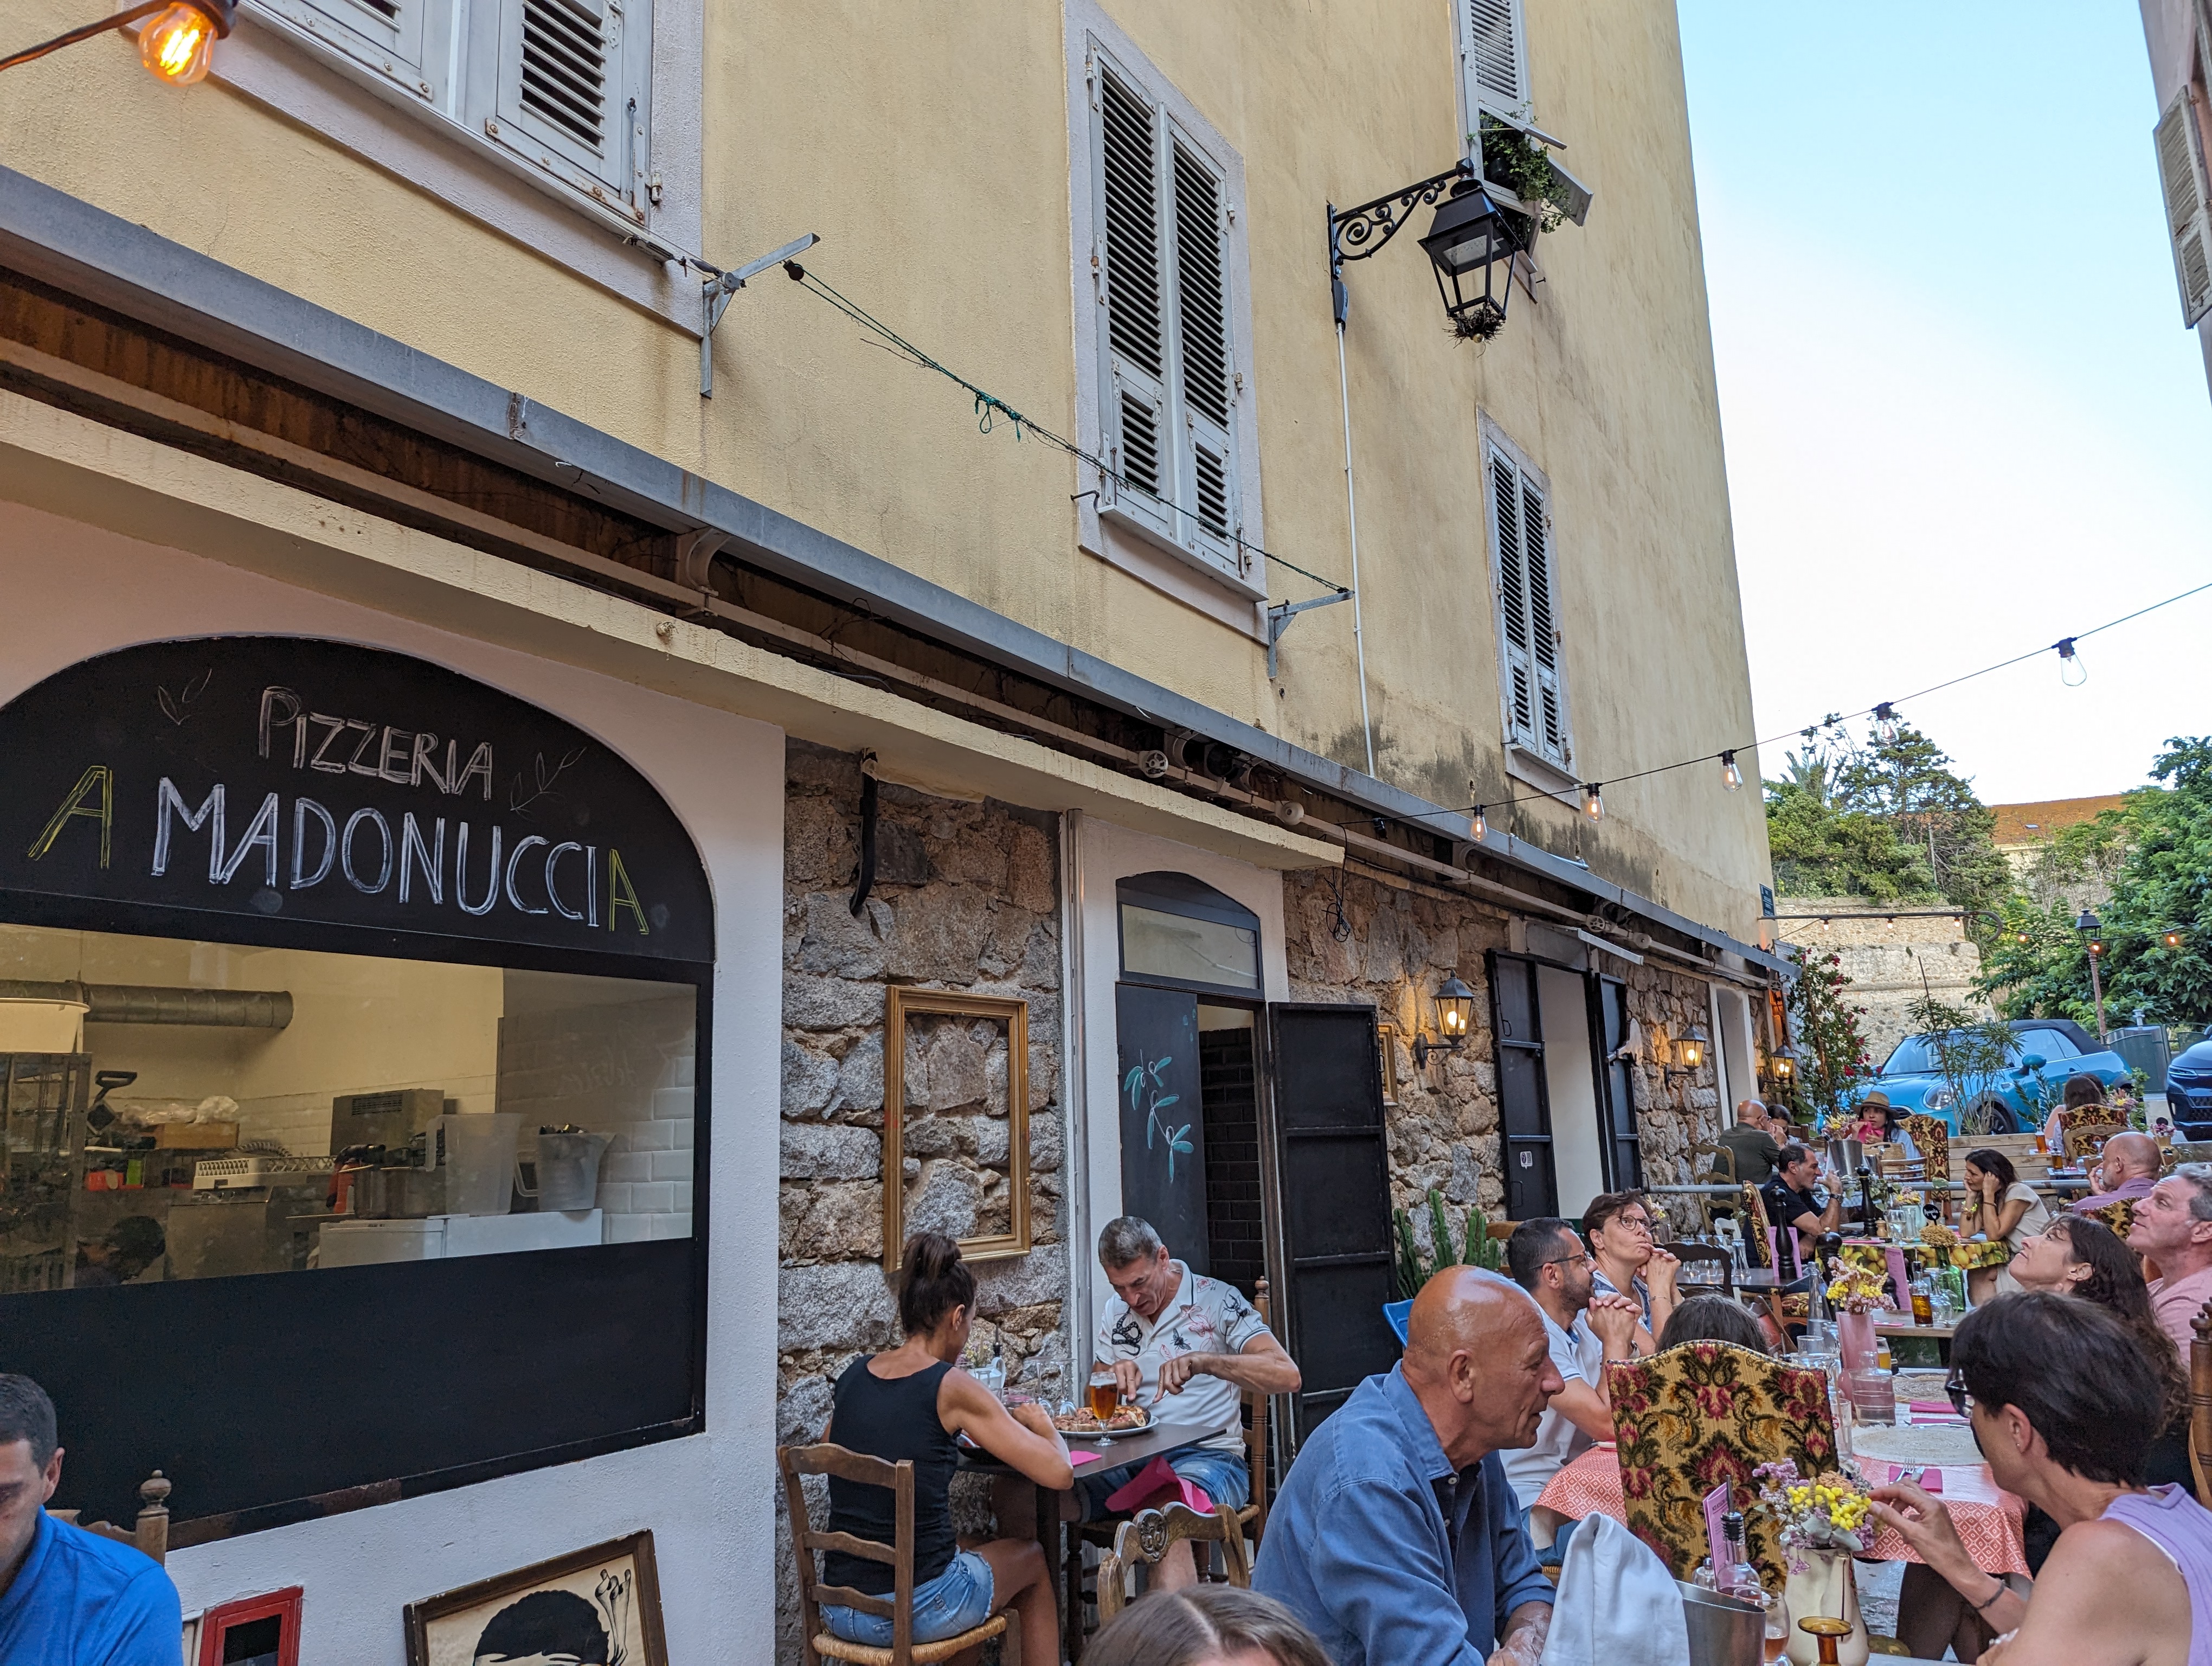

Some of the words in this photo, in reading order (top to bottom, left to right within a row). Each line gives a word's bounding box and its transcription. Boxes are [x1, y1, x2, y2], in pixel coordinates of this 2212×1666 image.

[259, 686, 492, 800] PIZZERIA
[27, 765, 111, 869] A
[150, 777, 650, 934] MADONUCCIA
